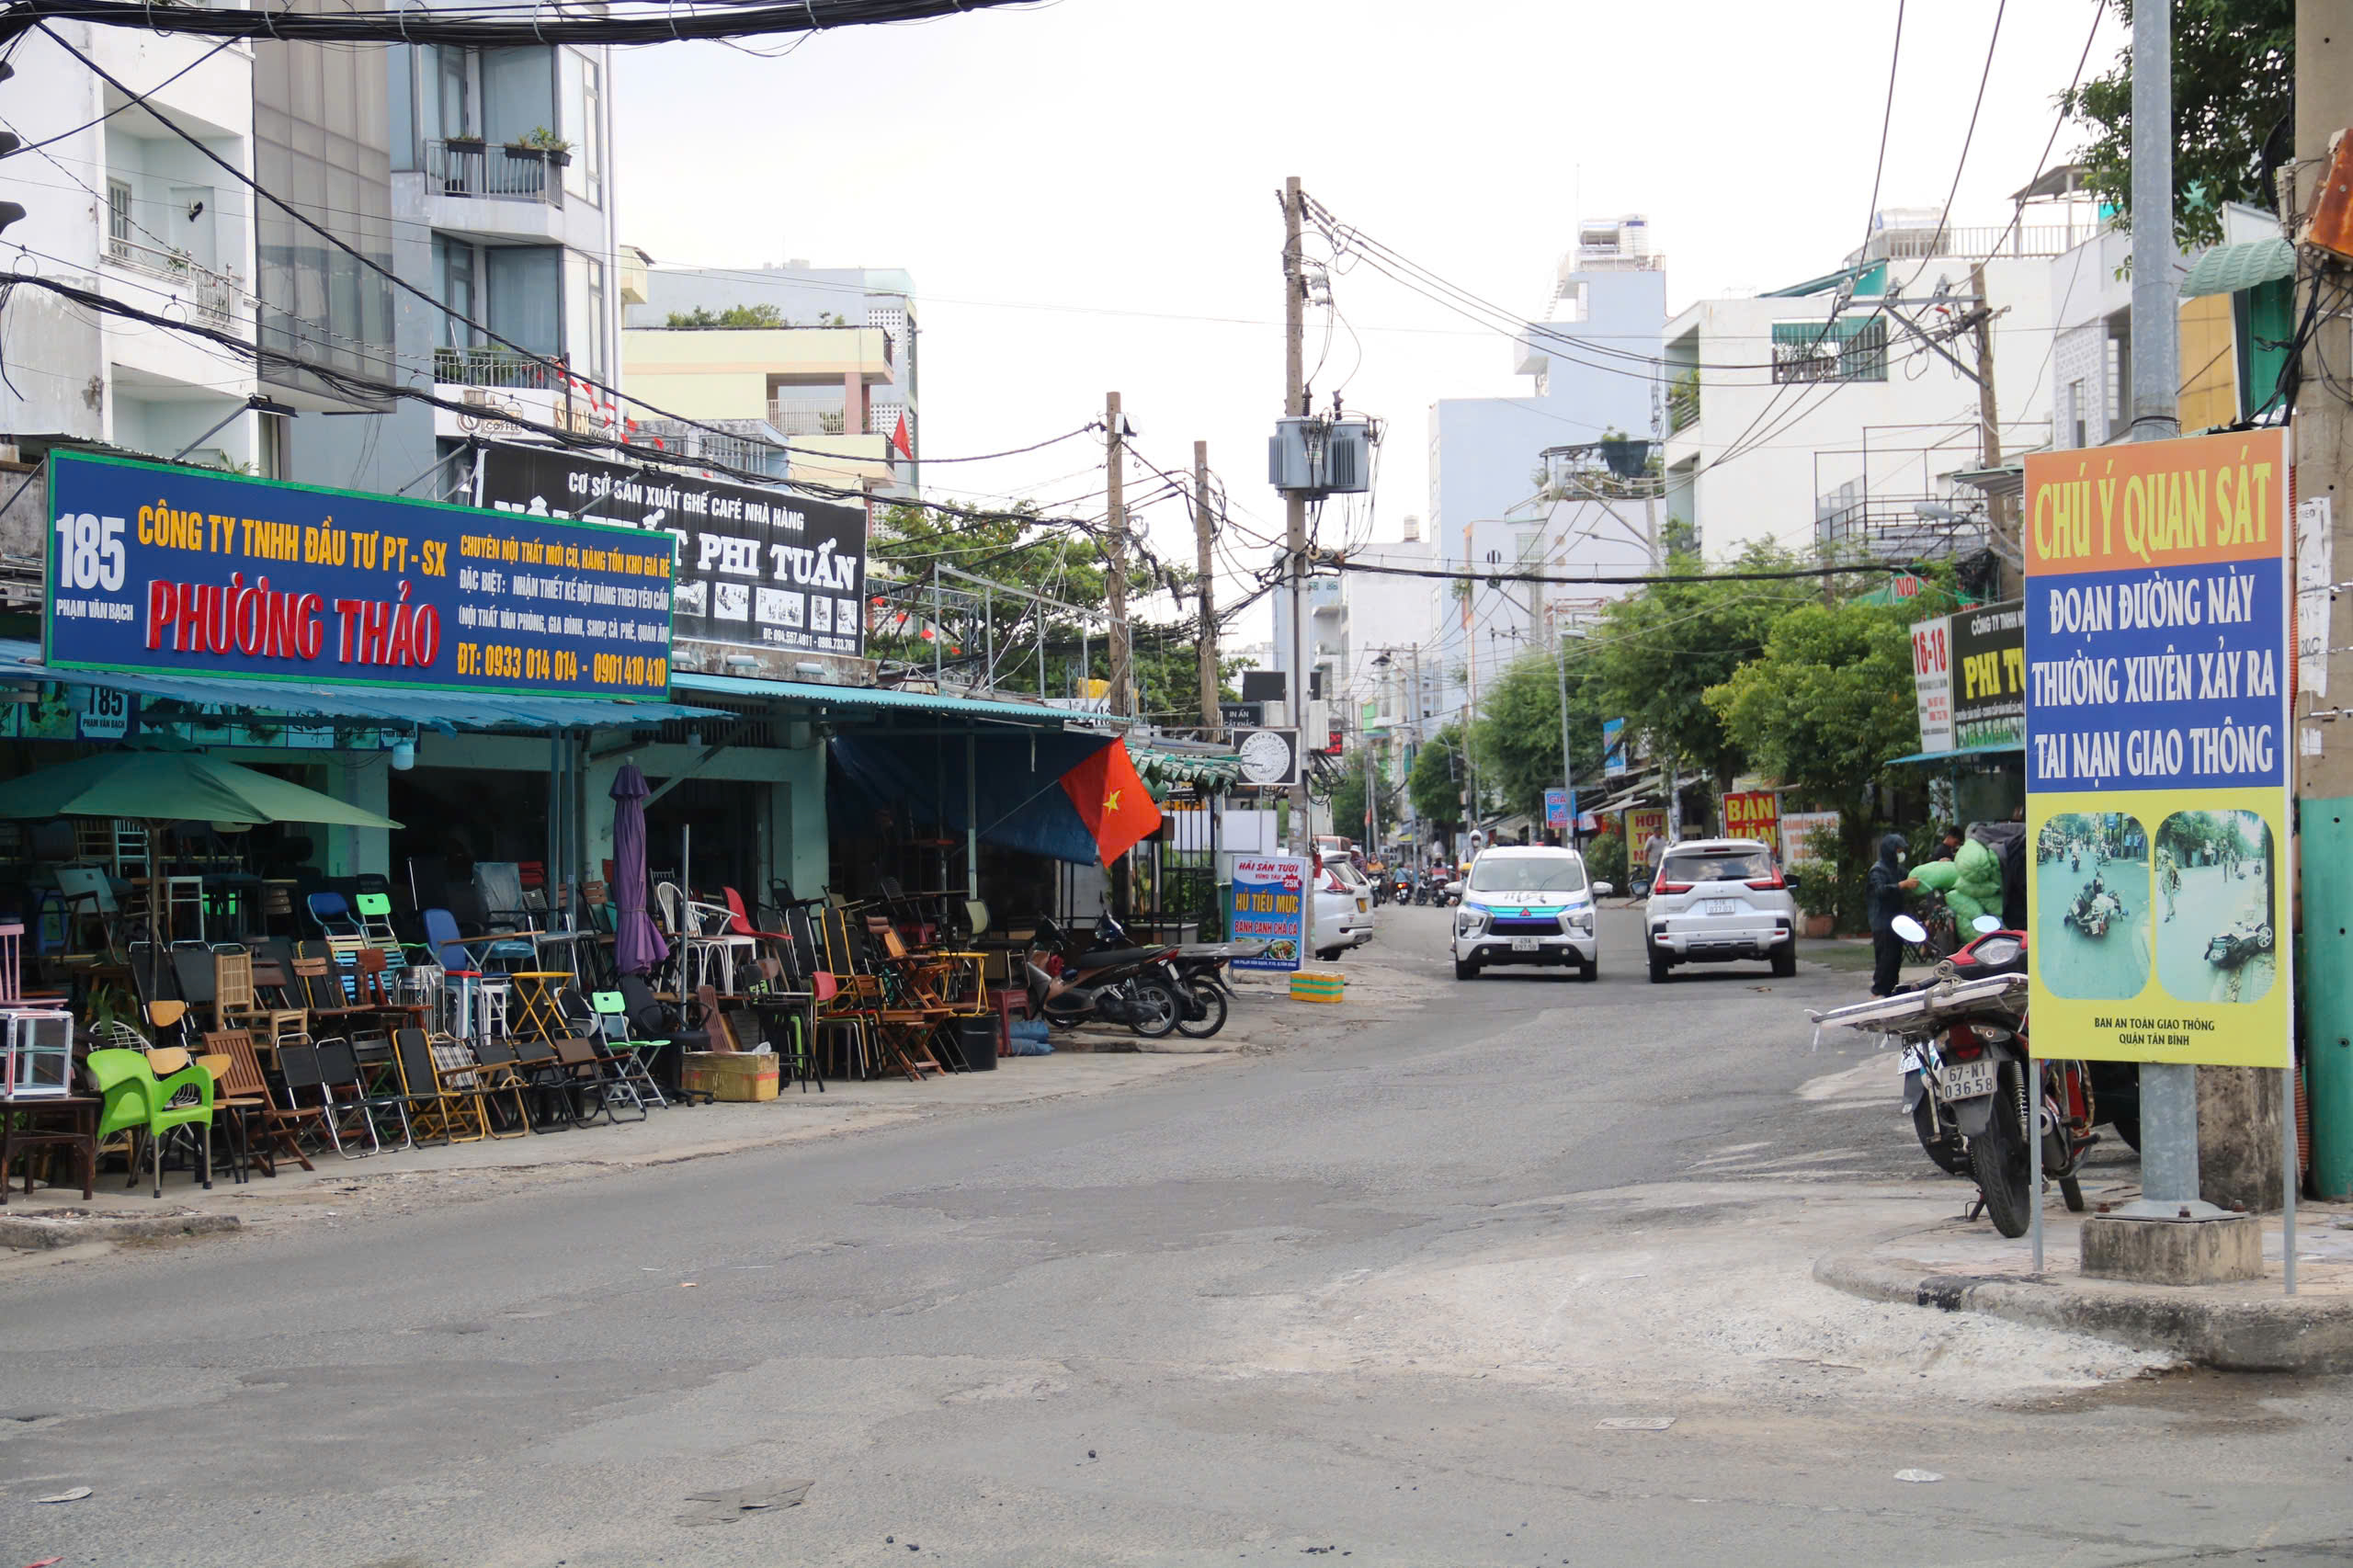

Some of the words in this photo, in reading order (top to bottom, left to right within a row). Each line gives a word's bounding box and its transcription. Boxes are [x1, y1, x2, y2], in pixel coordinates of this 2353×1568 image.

[568, 472, 589, 494] CƠ
[591, 471, 611, 497] SỞ
[645, 483, 680, 510] XUẤT
[683, 490, 710, 515] GHẾ
[710, 497, 742, 520] CAFÉ
[745, 502, 770, 525] NHÀ
[773, 506, 805, 531] HÀNG
[2034, 462, 2091, 560] CHÚ
[2098, 460, 2117, 555] Ý
[2123, 469, 2207, 564] QUAN
[2215, 445, 2272, 546] SÁT
[56, 513, 126, 592] 185
[137, 499, 202, 551] CÔNG
[208, 515, 236, 554] TY
[242, 519, 298, 562] TNHH
[304, 516, 347, 566] ĐẦU
[351, 531, 379, 570] TƯ
[382, 536, 409, 573] PT
[421, 540, 448, 577] SX
[460, 533, 500, 559] CHUYÊN
[502, 536, 518, 564] NỘI
[521, 537, 544, 564] THẤT
[545, 540, 564, 566] MỚI
[582, 545, 606, 572] HÀNG
[625, 554, 642, 574] KHO
[644, 553, 658, 577] GIÁ
[697, 532, 761, 576] PHI
[769, 537, 857, 591] TUẤN
[56, 599, 87, 621] PHẠM
[88, 597, 108, 619] VĂN
[108, 602, 133, 624] BẠCH
[460, 566, 479, 594] ĐẶC
[513, 573, 539, 600] NHẬN
[540, 574, 563, 599] THIẾT
[564, 576, 576, 601] KẾ
[593, 582, 617, 606] HÀNG
[617, 588, 637, 608] THEO
[638, 586, 654, 609] YÊU
[2050, 585, 2113, 642] ĐOẠN
[2119, 570, 2200, 630] ĐƯỜNG
[2207, 564, 2255, 625] NÀY
[145, 572, 324, 661] PHƯƠNG
[335, 580, 441, 668] THẢO
[478, 604, 498, 628] THẤT
[500, 608, 516, 630] VĂN
[548, 616, 562, 633] GIA
[608, 618, 618, 639] CÀ
[637, 622, 657, 642] QUÁN
[458, 642, 482, 676] ĐT:
[484, 644, 521, 678] 0933
[526, 648, 550, 680] 014
[554, 650, 578, 681] 014
[593, 653, 623, 685] 0901
[624, 655, 644, 686] 410
[645, 657, 667, 687] 410
[1913, 627, 1947, 675] 16-18
[2031, 649, 2119, 707] THƯỜNG
[2124, 644, 2192, 703] XUYÊN
[2198, 635, 2242, 699] XẢY
[2246, 649, 2277, 699] RA
[1963, 651, 2001, 700] PHI
[2034, 733, 2067, 779] TAI
[2073, 731, 2120, 788] NẠN
[2126, 728, 2183, 777] GIAO
[2188, 715, 2273, 776] THÔNG
[1284, 879, 1299, 888] 25K
[2095, 1017, 2112, 1028] BAN
[2115, 1017, 2127, 1029] AN
[2130, 1016, 2154, 1029] TOÀN
[2157, 1018, 2179, 1030] GIAO
[2182, 1017, 2215, 1031] THÔNG
[2119, 1033, 2145, 1046] QUẬN
[1945, 1077, 1993, 1099] 036.58
[1949, 1062, 1985, 1082] 67-N1
